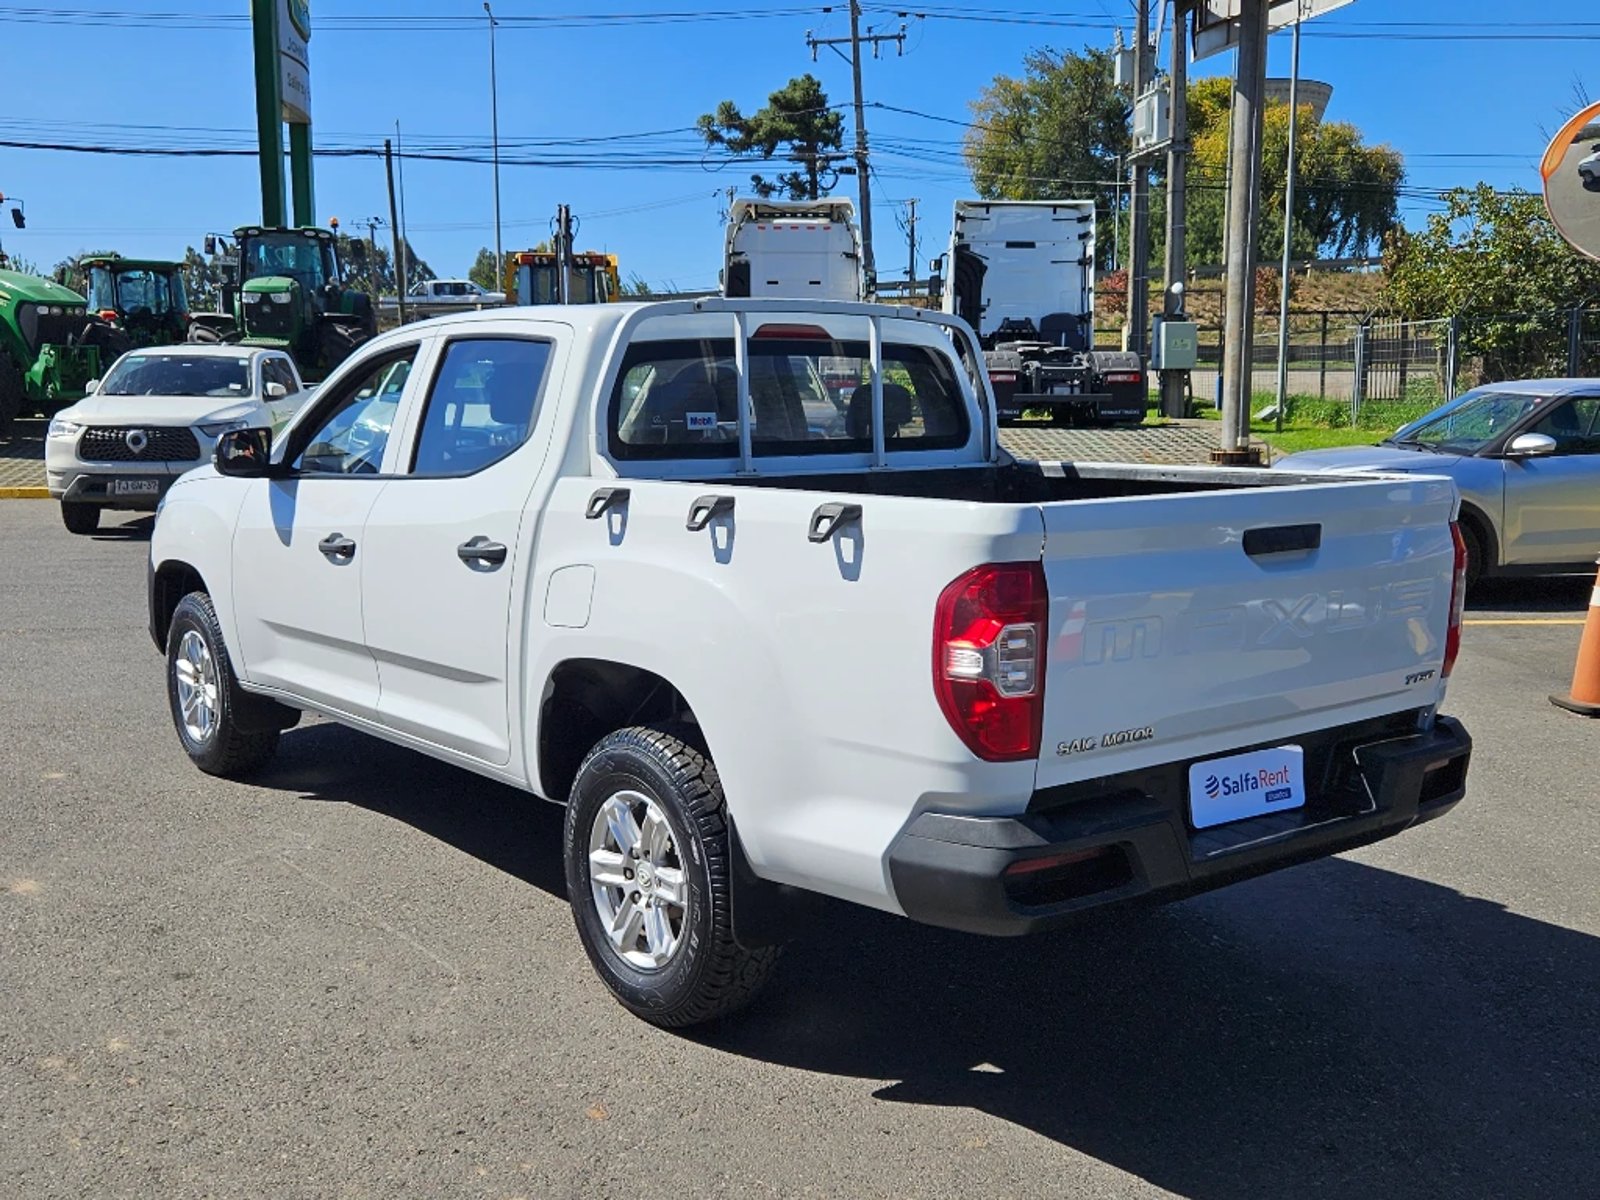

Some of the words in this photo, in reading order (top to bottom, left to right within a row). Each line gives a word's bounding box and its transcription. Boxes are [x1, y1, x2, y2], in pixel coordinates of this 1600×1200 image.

[1056, 738, 1097, 756] SAIC
[1101, 727, 1154, 748] MOTOR
[1221, 765, 1290, 796] SalfaRent
